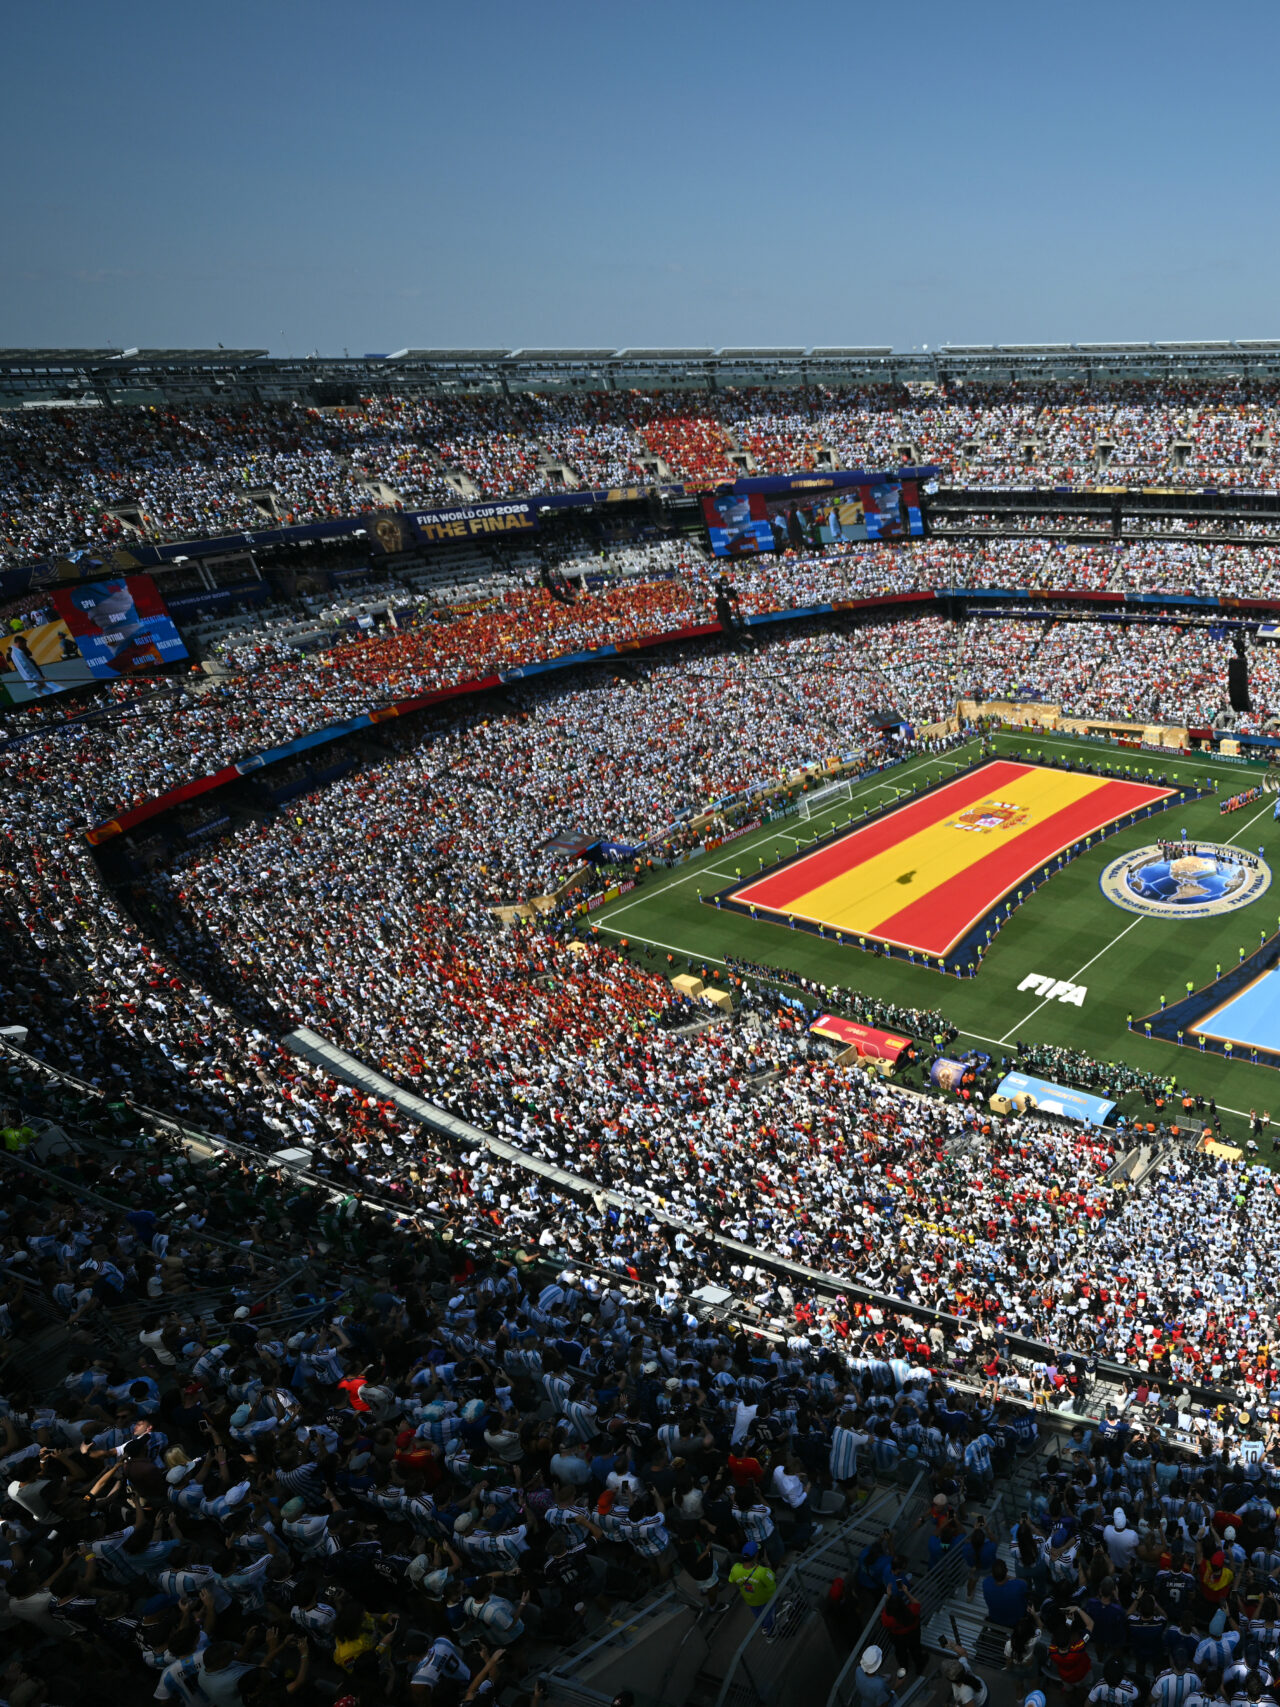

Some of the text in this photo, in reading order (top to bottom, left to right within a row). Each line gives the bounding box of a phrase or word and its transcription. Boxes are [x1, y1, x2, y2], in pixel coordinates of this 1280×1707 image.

[416, 504, 530, 525] FIFA WORLD CUP 2026
[420, 513, 534, 540] THE FINAL
[93, 632, 125, 646] ARGENTINA
[1140, 744, 1184, 756] McDonald's
[1210, 754, 1248, 765] Hisense
[722, 821, 762, 844] McDonald's
[1228, 874, 1264, 905] THE FINAL
[1122, 898, 1150, 911] WORLD
[1016, 972, 1088, 1007] FIFA
[1244, 1450, 1258, 1464] 10
[1169, 1588, 1181, 1603] 9
